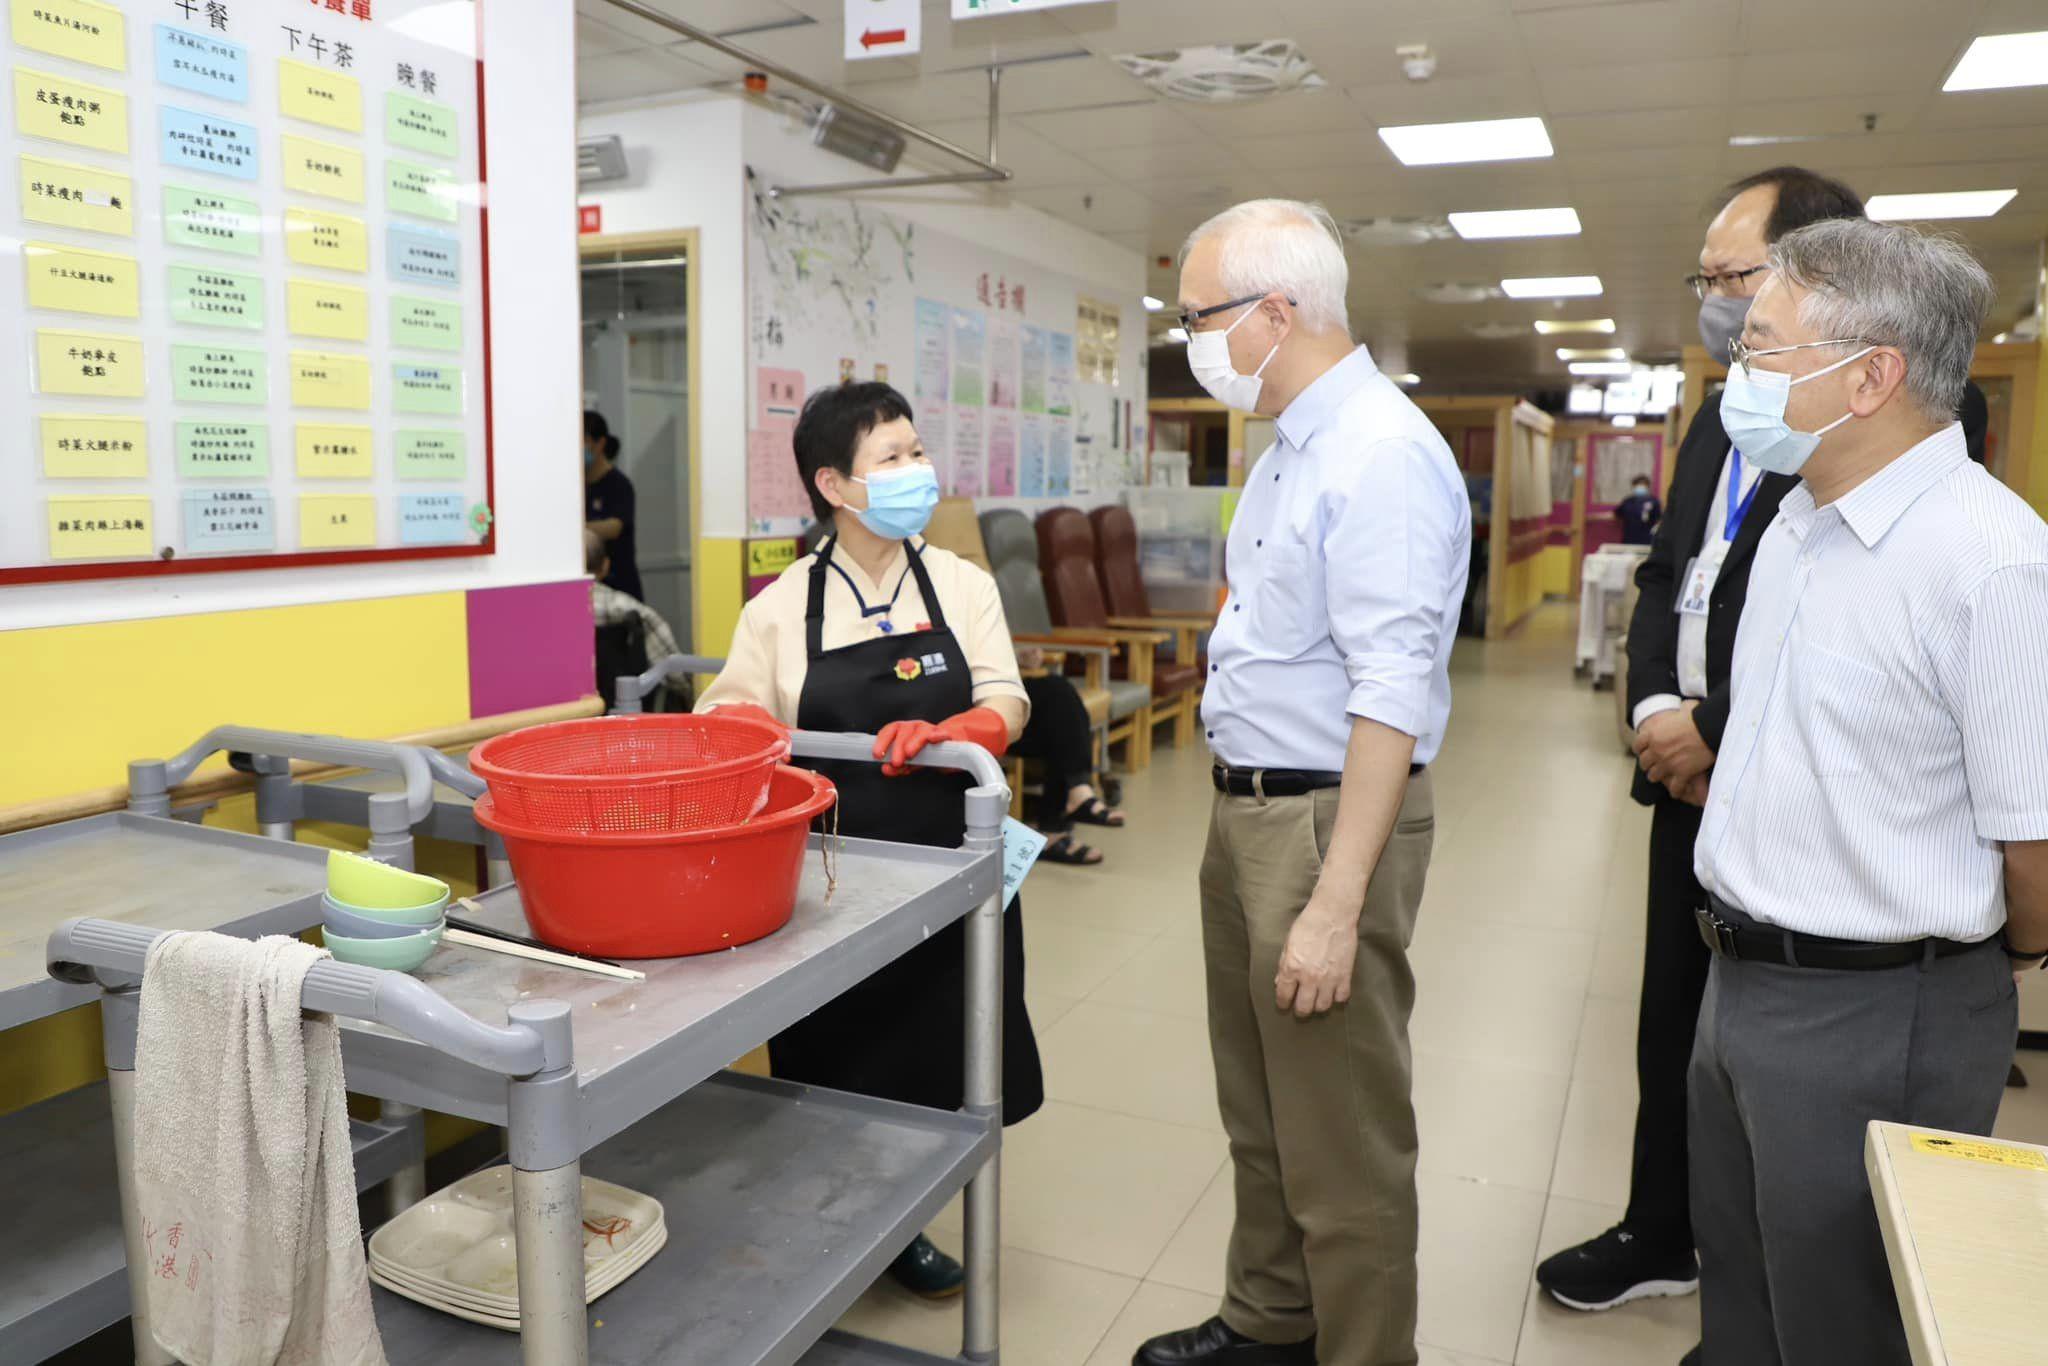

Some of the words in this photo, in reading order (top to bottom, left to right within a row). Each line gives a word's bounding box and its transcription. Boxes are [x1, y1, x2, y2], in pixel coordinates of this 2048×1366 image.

[174, 0, 229, 32] 午餐
[280, 25, 353, 68] 下午茶
[397, 62, 438, 95] 晚餐
[35, 88, 102, 115] 皮蛋瘦肉粥
[31, 181, 83, 203] 時菜瘦肉
[67, 346, 119, 363] 牛奶麥皮
[58, 437, 134, 453] 時菜火腿米粉
[57, 518, 146, 533] 雜菜肉絲上海麵
[154, 1222, 184, 1280] 香港
